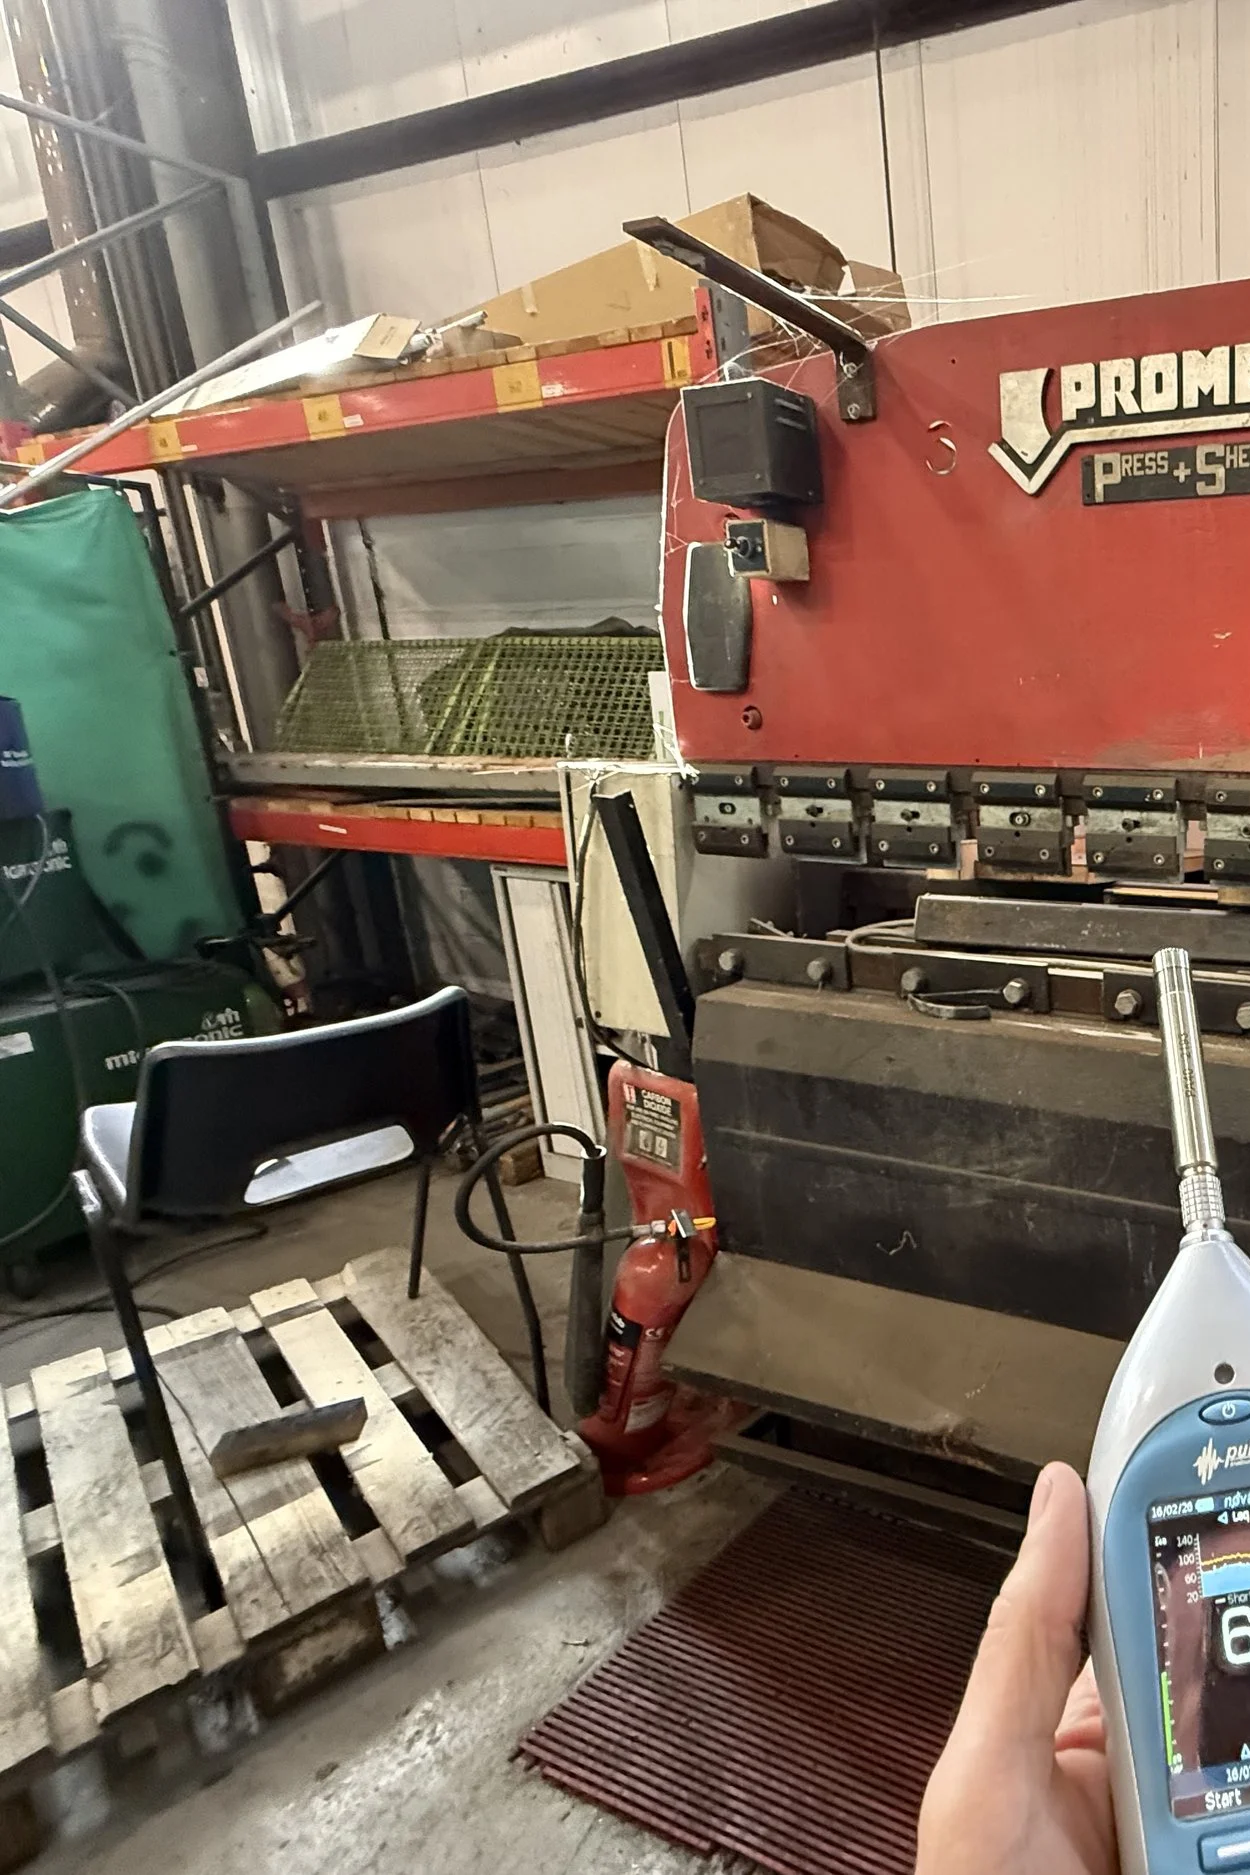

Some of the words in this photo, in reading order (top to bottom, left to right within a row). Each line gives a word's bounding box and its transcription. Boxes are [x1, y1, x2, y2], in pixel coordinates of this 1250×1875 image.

[1095, 451, 1169, 503] PRESS
[1173, 463, 1191, 484] +
[1176, 1534, 1193, 1547] 140
[1178, 1553, 1195, 1566] 100
[1184, 1573, 1197, 1585] 60
[1186, 1591, 1199, 1604] 20
[1204, 1788, 1242, 1811] Start
